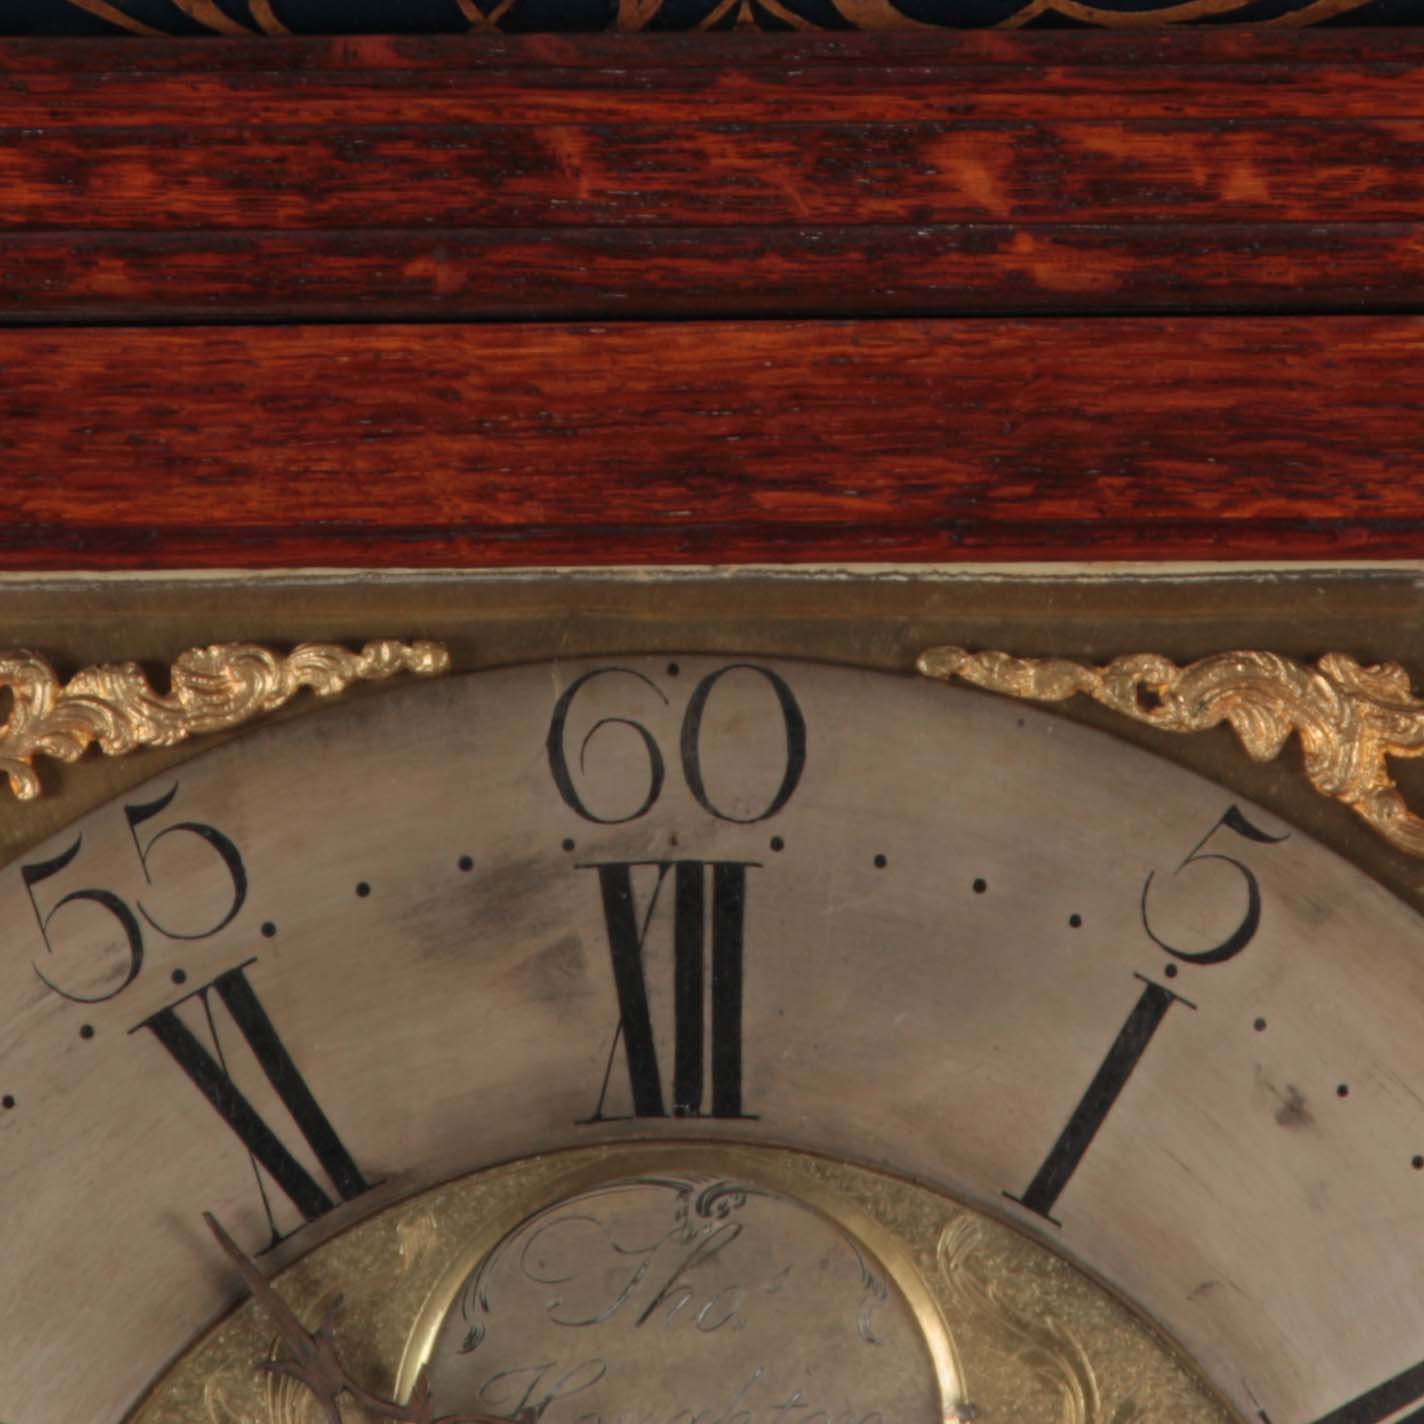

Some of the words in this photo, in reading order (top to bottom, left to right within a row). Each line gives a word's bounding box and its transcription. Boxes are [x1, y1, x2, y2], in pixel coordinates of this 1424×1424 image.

[547, 663, 807, 825] 60
[21, 780, 248, 1004] 55
[574, 859, 763, 1126] XII
[1140, 803, 1291, 966] 5
[128, 956, 386, 1257] XI
[1001, 972, 1198, 1229] I
